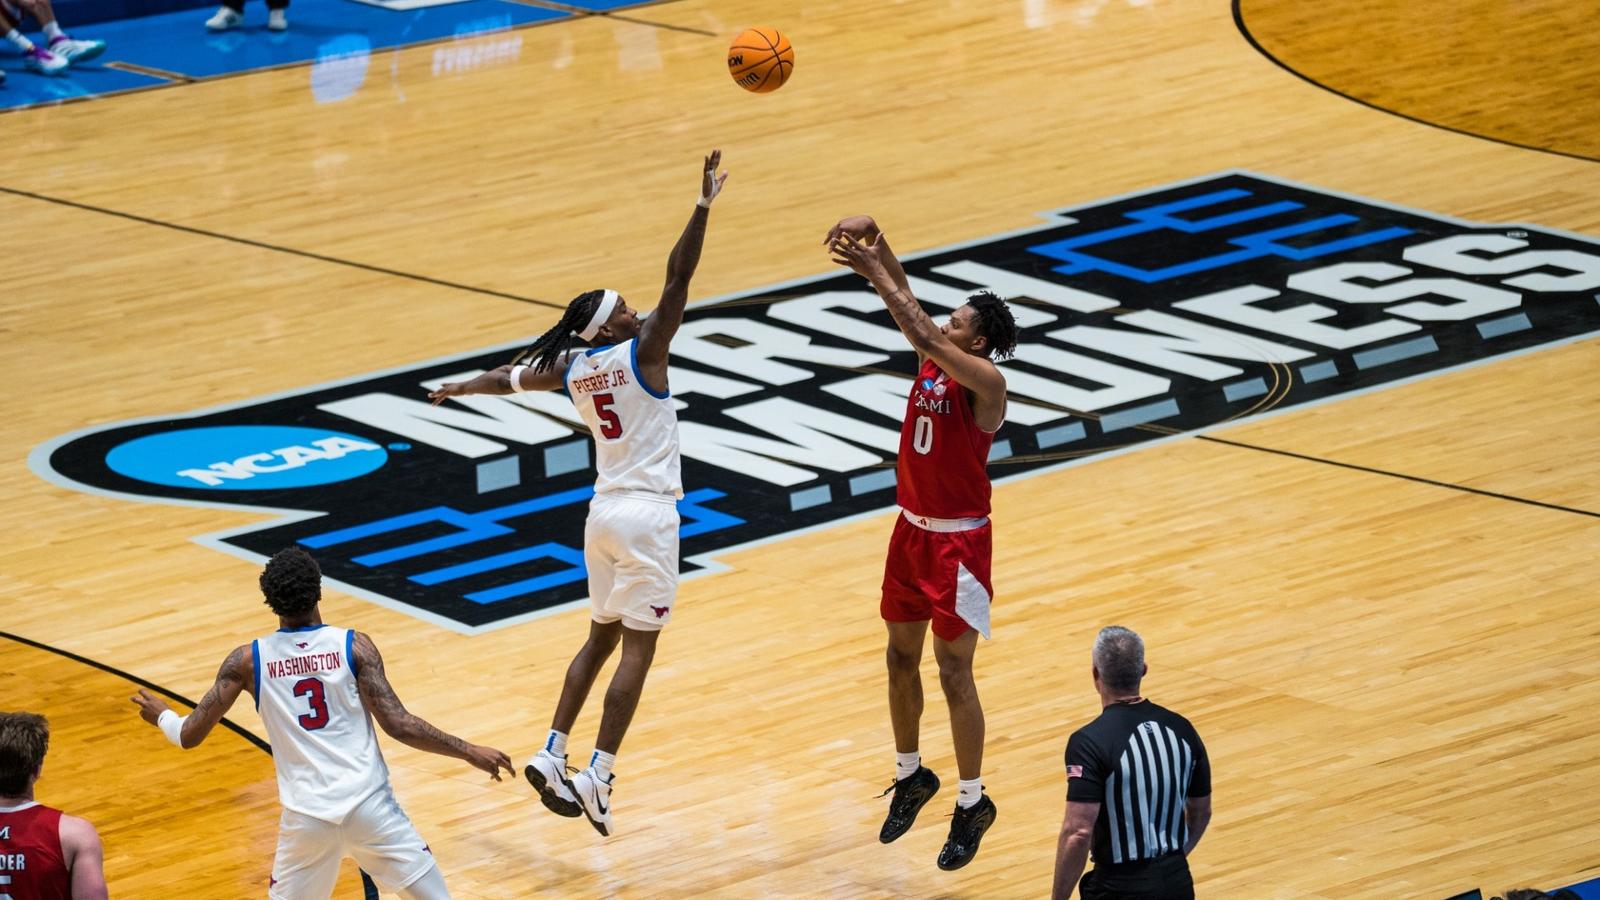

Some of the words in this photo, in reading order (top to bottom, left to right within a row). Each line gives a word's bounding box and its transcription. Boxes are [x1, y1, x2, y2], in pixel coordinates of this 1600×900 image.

[612, 369, 630, 387] JR.
[592, 393, 623, 439] 5
[913, 415, 933, 455] 0
[176, 436, 382, 486] NCAA
[266, 652, 341, 679] WASHINGTON
[293, 677, 330, 731] 3
